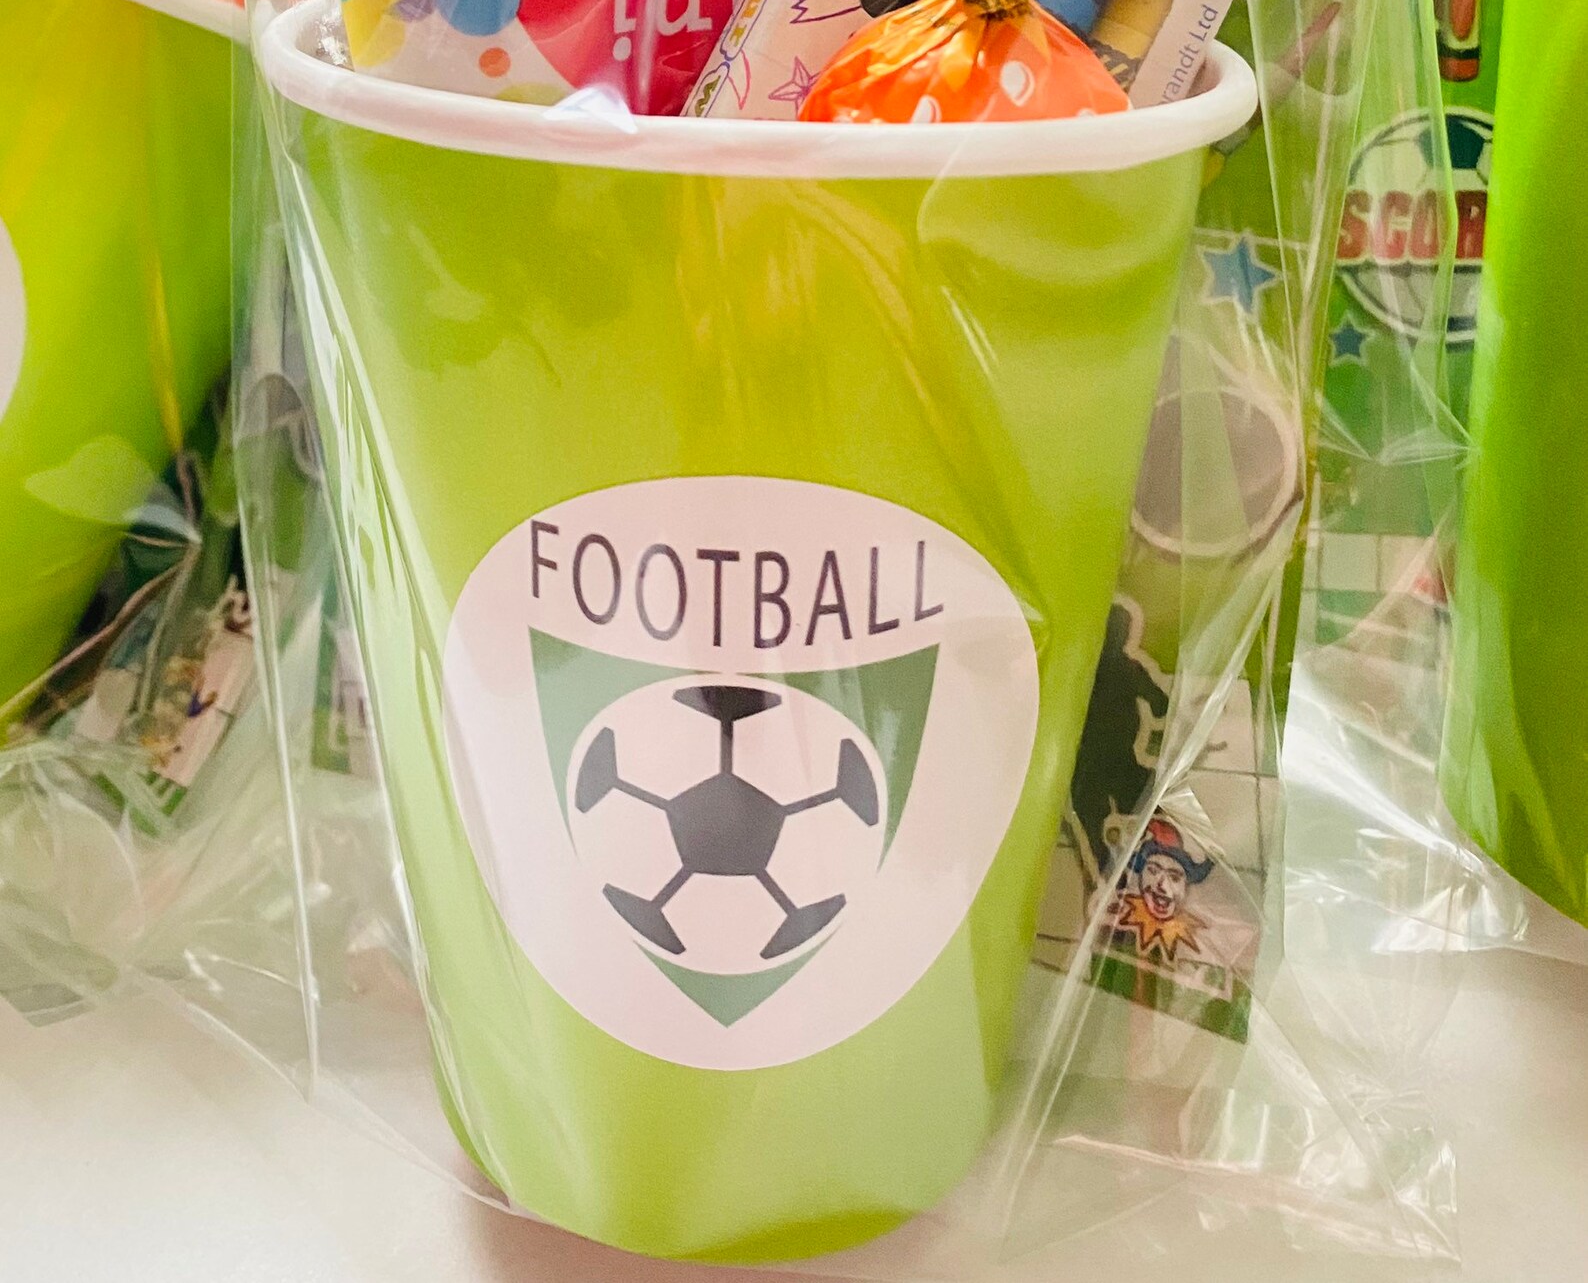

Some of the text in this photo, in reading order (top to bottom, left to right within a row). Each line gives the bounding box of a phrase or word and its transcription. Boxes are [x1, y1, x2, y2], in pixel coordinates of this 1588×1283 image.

[1188, 4, 1219, 43] Ltd
[1336, 189, 1488, 259] SCOR
[529, 519, 944, 649] FOOTBALL
